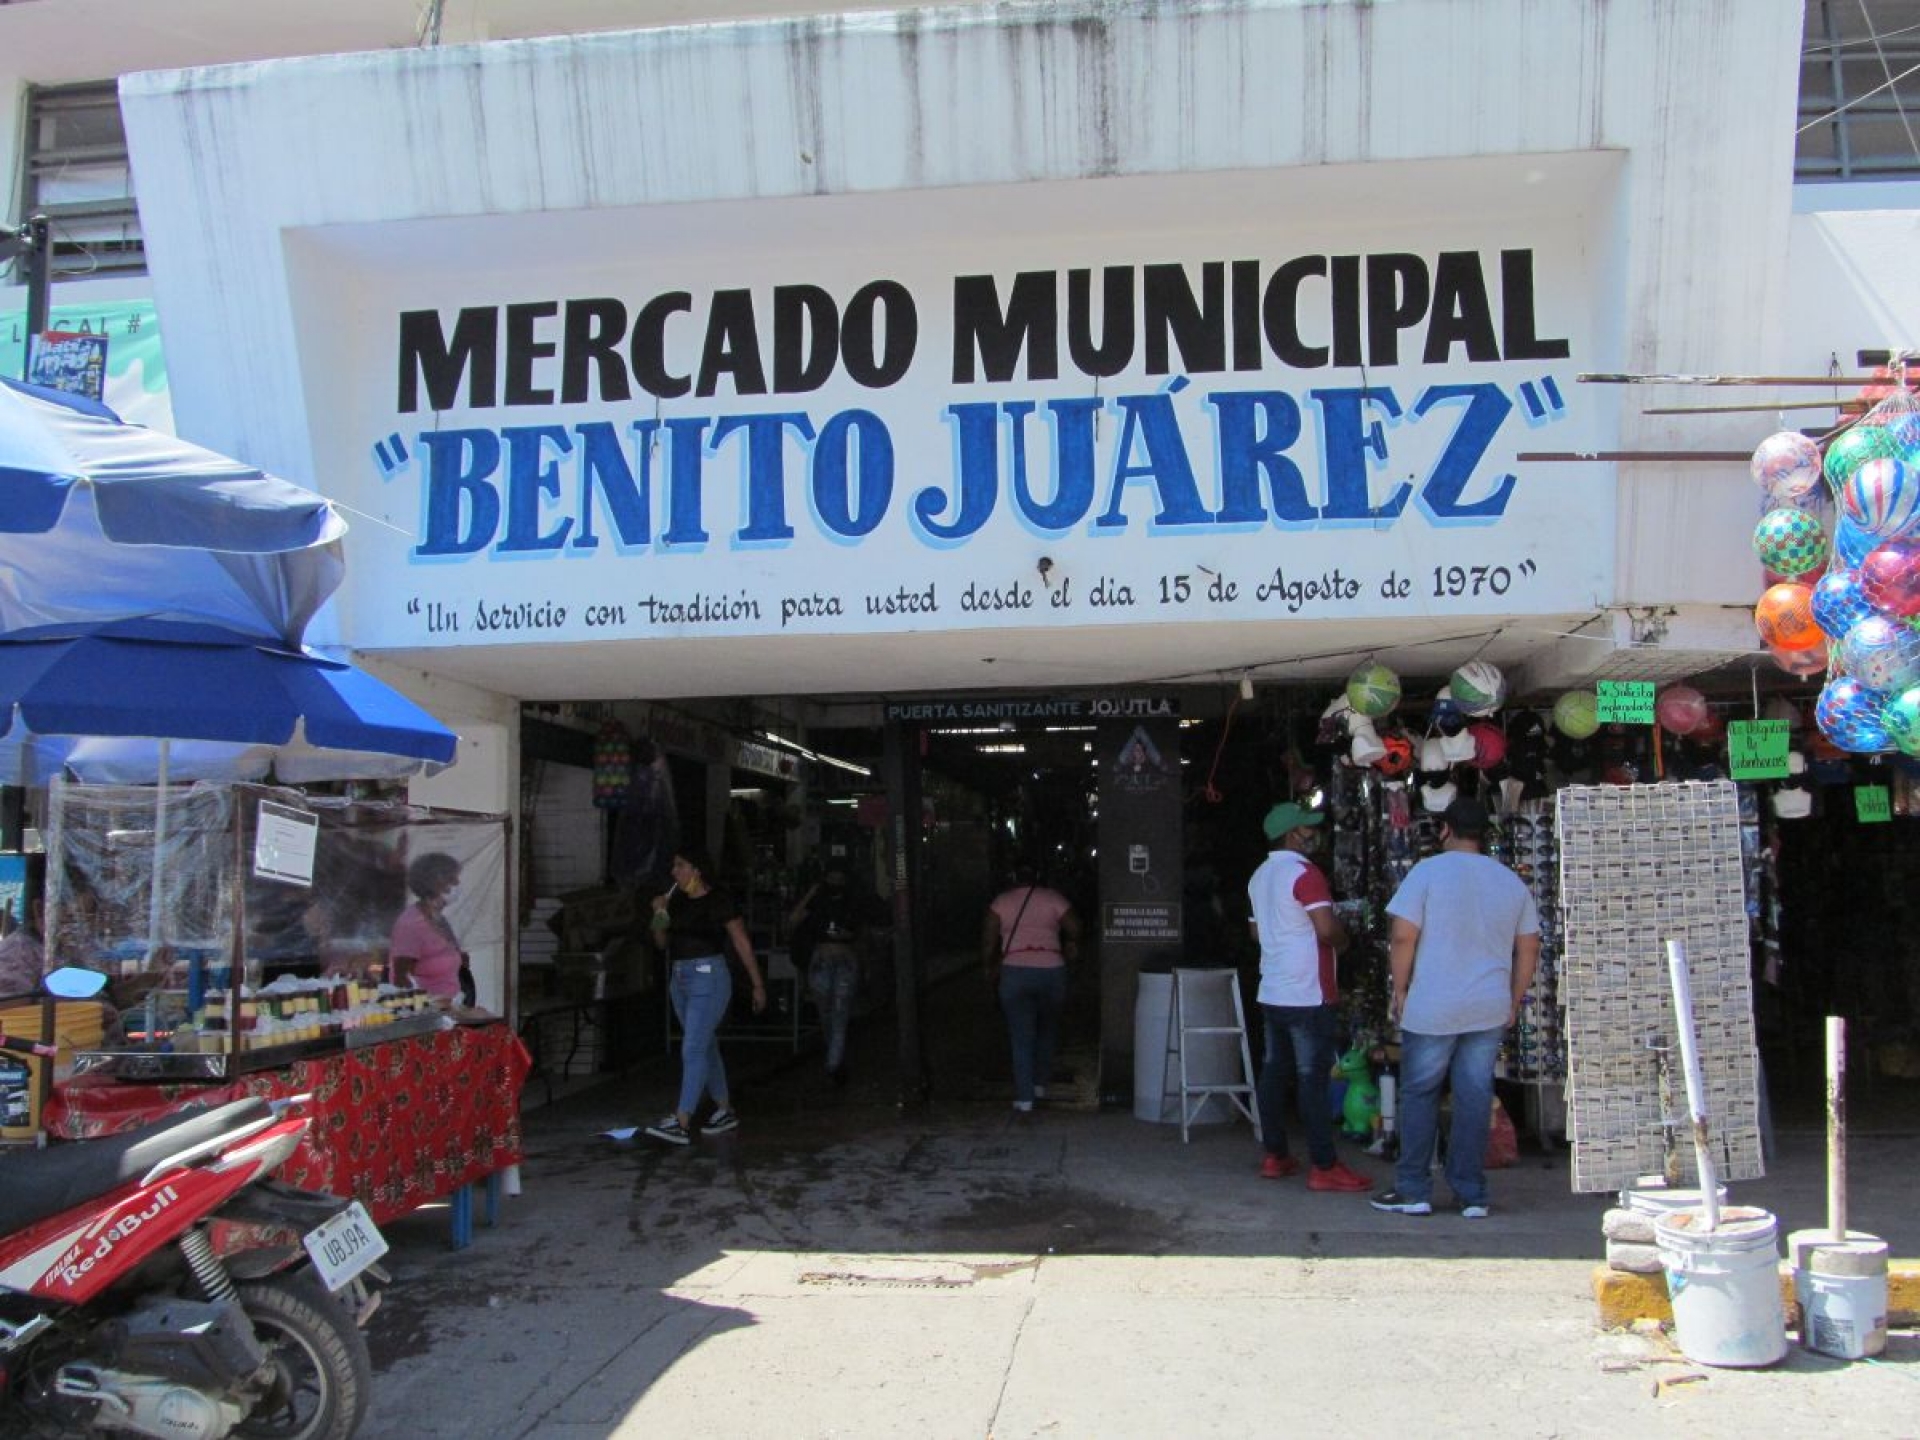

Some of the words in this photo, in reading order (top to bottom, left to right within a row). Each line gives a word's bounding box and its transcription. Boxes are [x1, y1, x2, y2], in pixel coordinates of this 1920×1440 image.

[397, 279, 918, 414] MERCADO
[952, 248, 1570, 384] MUNICIPAL
[371, 408, 895, 566] "BENITO
[910, 375, 1566, 552] JUÁREZ"
[584, 602, 626, 626] con
[638, 589, 762, 624] tradición
[781, 591, 844, 627] para
[865, 581, 939, 616] usted
[960, 580, 1034, 612] desde
[1050, 577, 1072, 608] el
[1159, 575, 1192, 604] 15
[1207, 572, 1239, 603] de
[1255, 566, 1363, 613] Agosto
[1379, 569, 1412, 600] de
[1432, 557, 1538, 598] 1970"
[888, 703, 958, 720] PUERTA
[962, 701, 1081, 719] SANITIZANTE
[1087, 698, 1173, 716] JOJUTLA
[62, 1235, 113, 1286] Red
[116, 1185, 178, 1236] Bull
